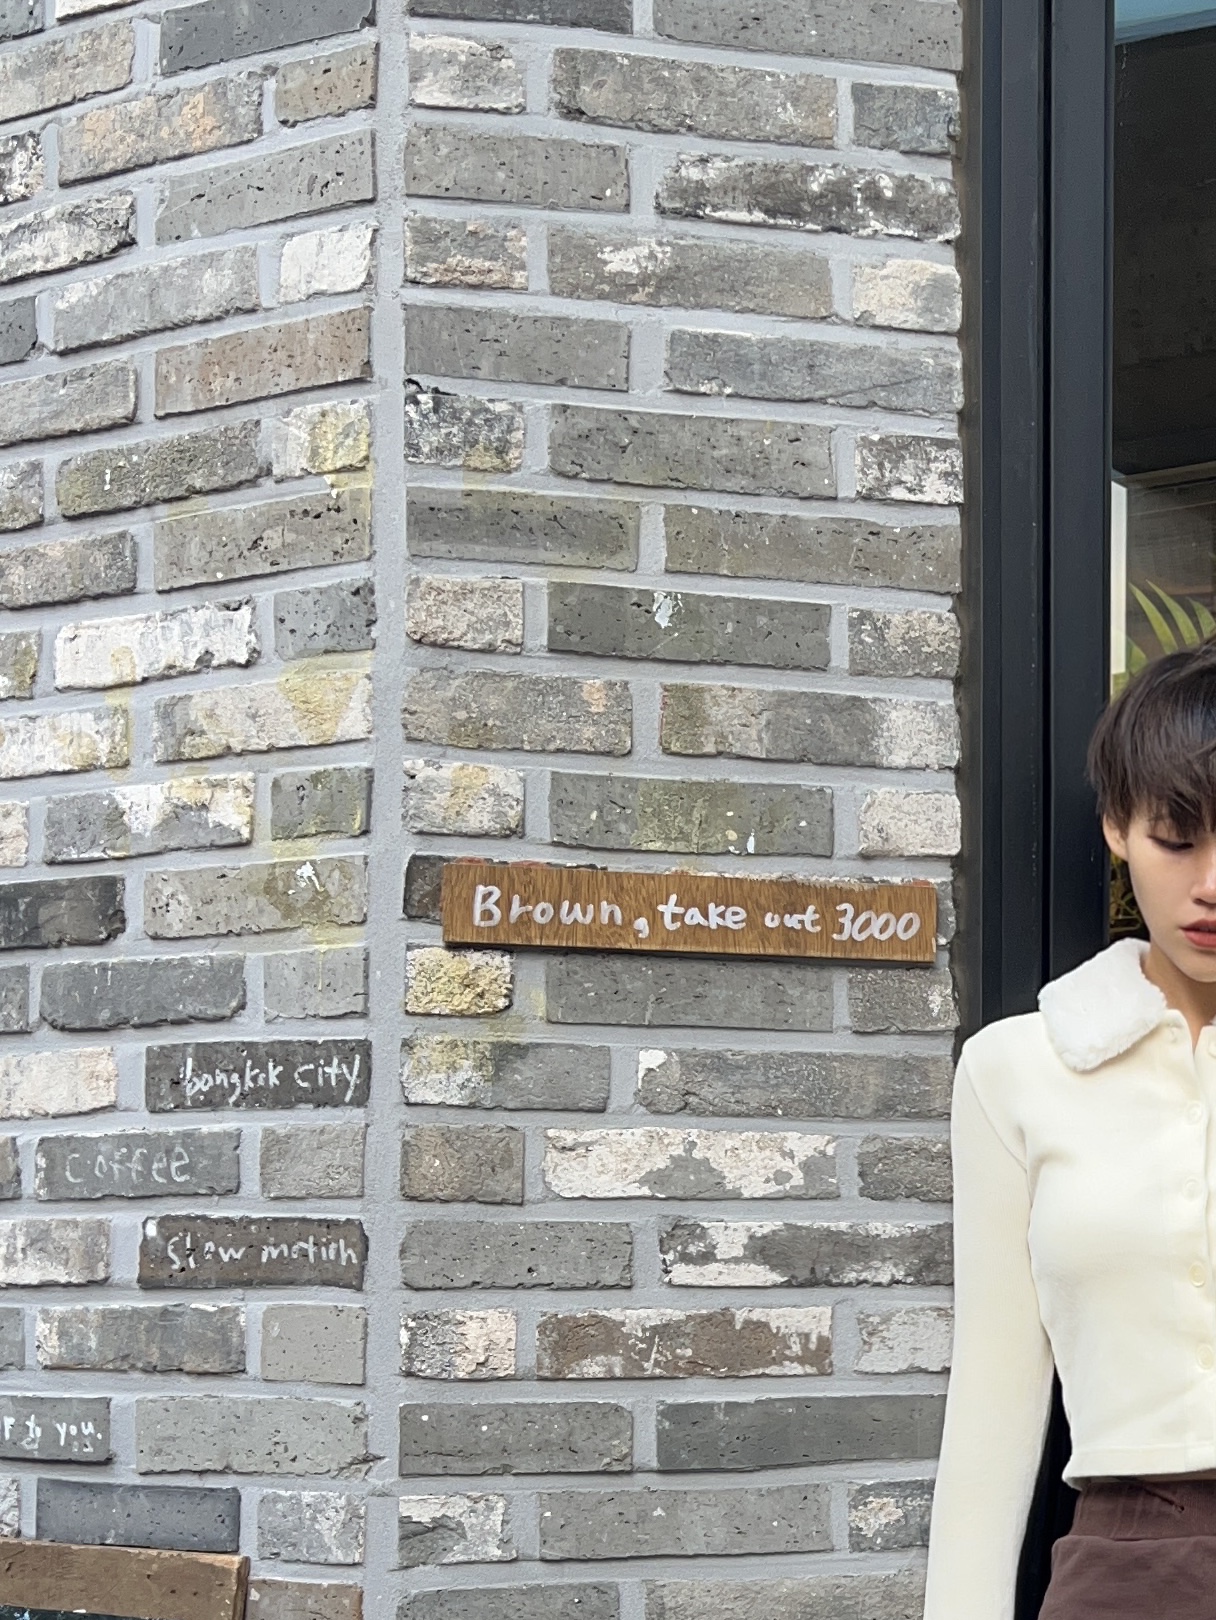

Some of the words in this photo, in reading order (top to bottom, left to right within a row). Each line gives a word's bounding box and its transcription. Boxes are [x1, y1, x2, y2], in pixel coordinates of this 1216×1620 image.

[657, 893, 748, 931] take
[764, 905, 822, 933] out
[832, 902, 921, 942] 3000
[25, 1414, 42, 1438] to
